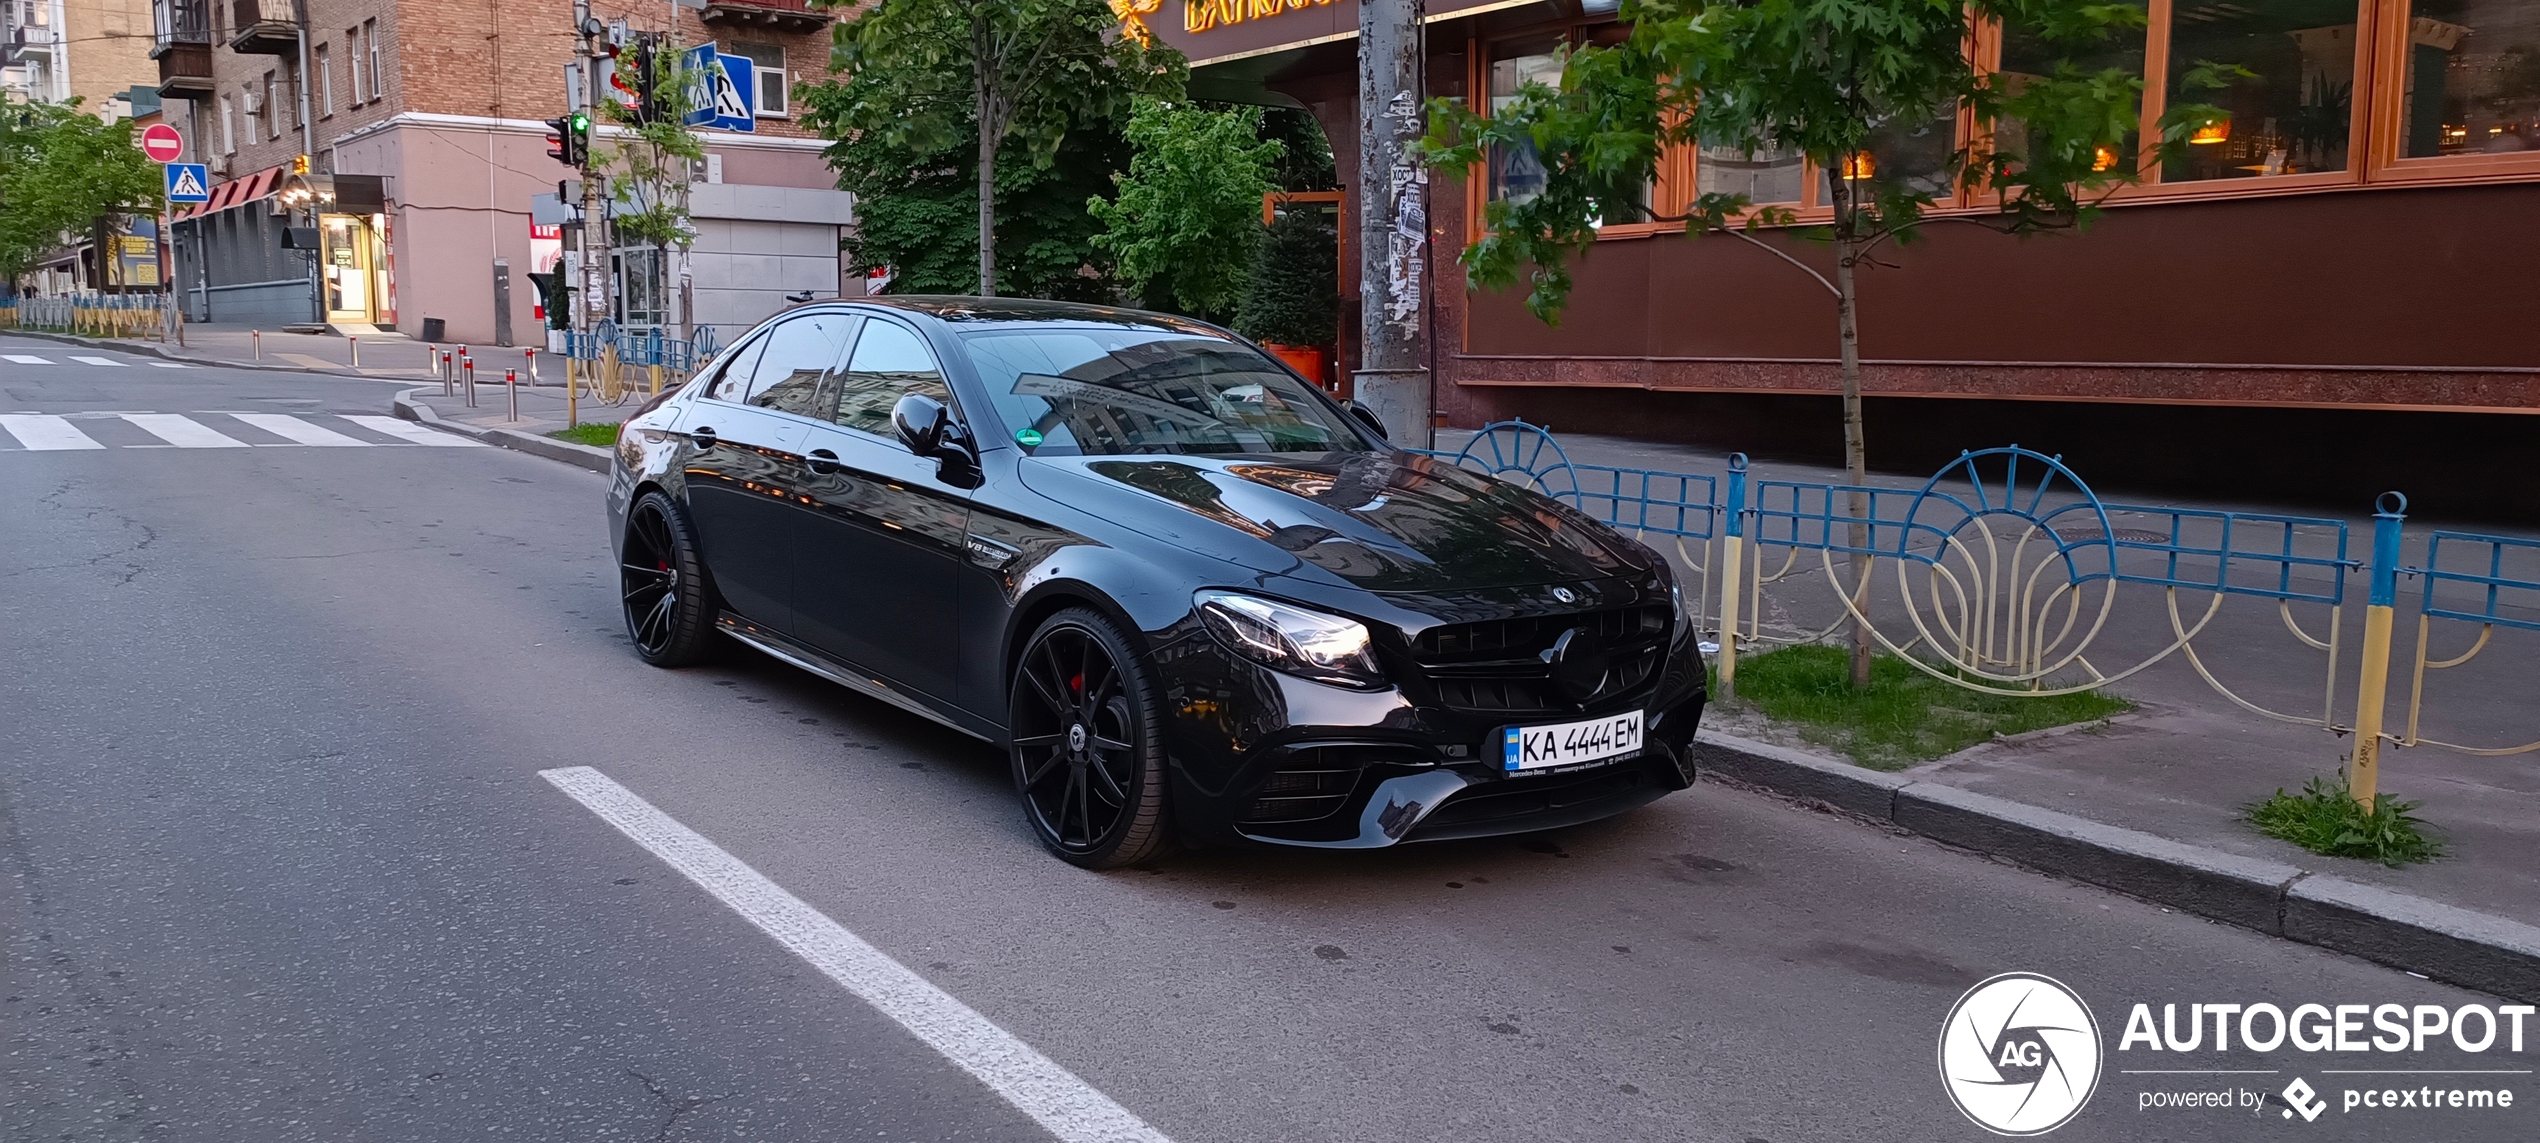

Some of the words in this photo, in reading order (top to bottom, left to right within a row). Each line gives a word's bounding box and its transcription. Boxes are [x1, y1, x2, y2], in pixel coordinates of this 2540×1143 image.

[967, 540, 983, 552] V8
[1523, 731, 1558, 763] KA
[1564, 722, 1611, 757] 4444
[1615, 715, 1639, 749] EM
[1506, 754, 1519, 765] UA
[1508, 769, 1547, 779] Mercedes-Benz
